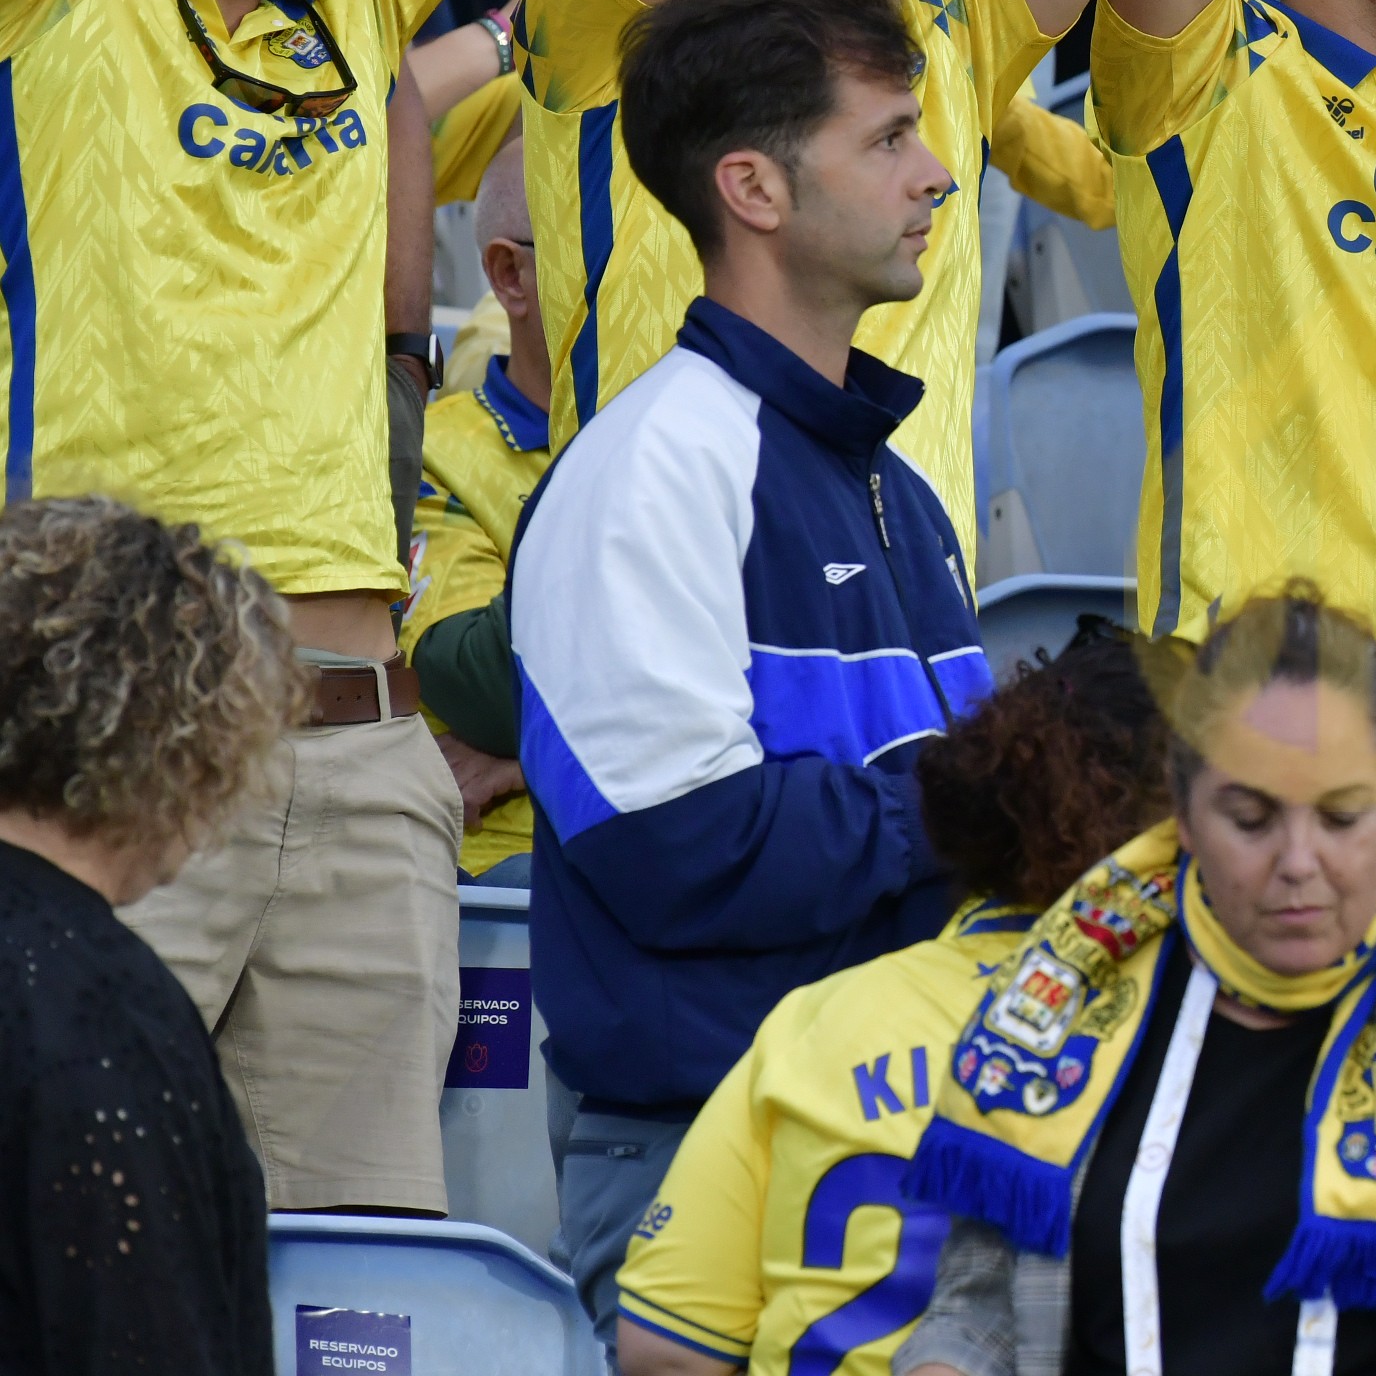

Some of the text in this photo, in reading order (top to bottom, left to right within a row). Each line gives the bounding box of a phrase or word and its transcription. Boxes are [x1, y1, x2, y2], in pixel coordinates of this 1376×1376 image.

[459, 999, 520, 1011] SERVADO
[458, 1014, 508, 1025] QUIPOS
[309, 1339, 398, 1358] RESERVADO
[322, 1356, 387, 1372] EQUIPOS
